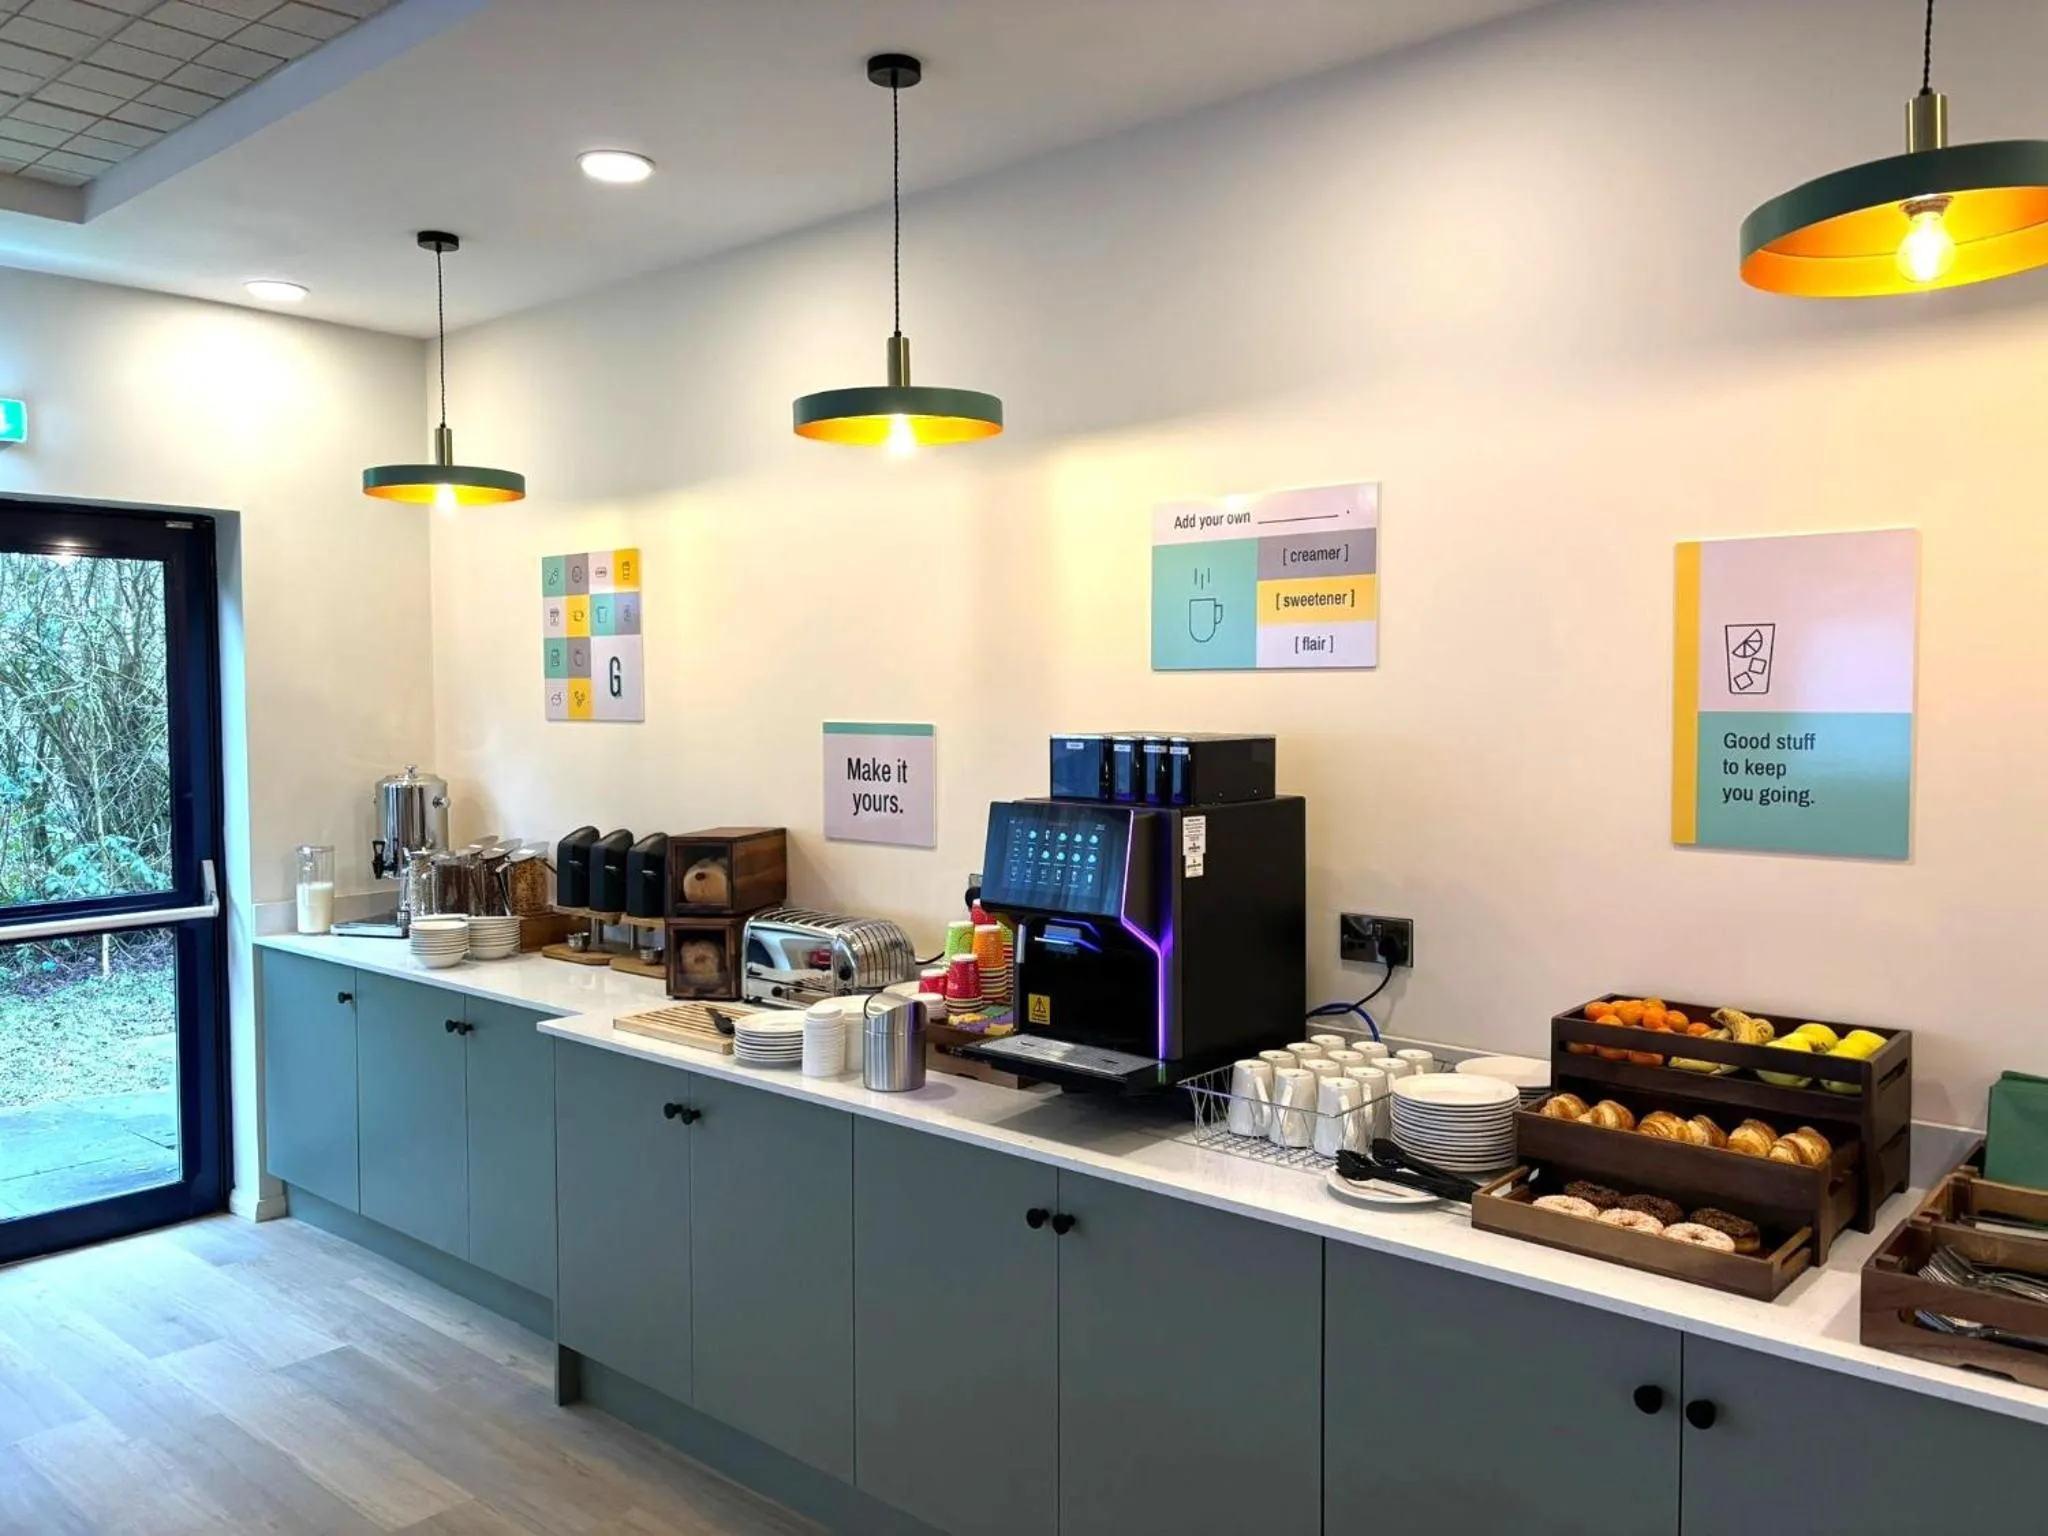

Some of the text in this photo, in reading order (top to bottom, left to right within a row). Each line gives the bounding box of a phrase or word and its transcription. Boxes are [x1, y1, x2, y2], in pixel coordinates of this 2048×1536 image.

[1174, 512, 1251, 530] Add your own
[1290, 548, 1341, 563] creamer
[1283, 591, 1347, 608] sweetener
[1302, 636, 1326, 651] flair
[609, 656, 621, 698] G
[1723, 732, 1816, 750] Good stuff
[847, 757, 908, 783] Make it
[1723, 759, 1787, 779] to keep
[852, 792, 904, 816] yours.
[1723, 785, 1815, 808] you going.
